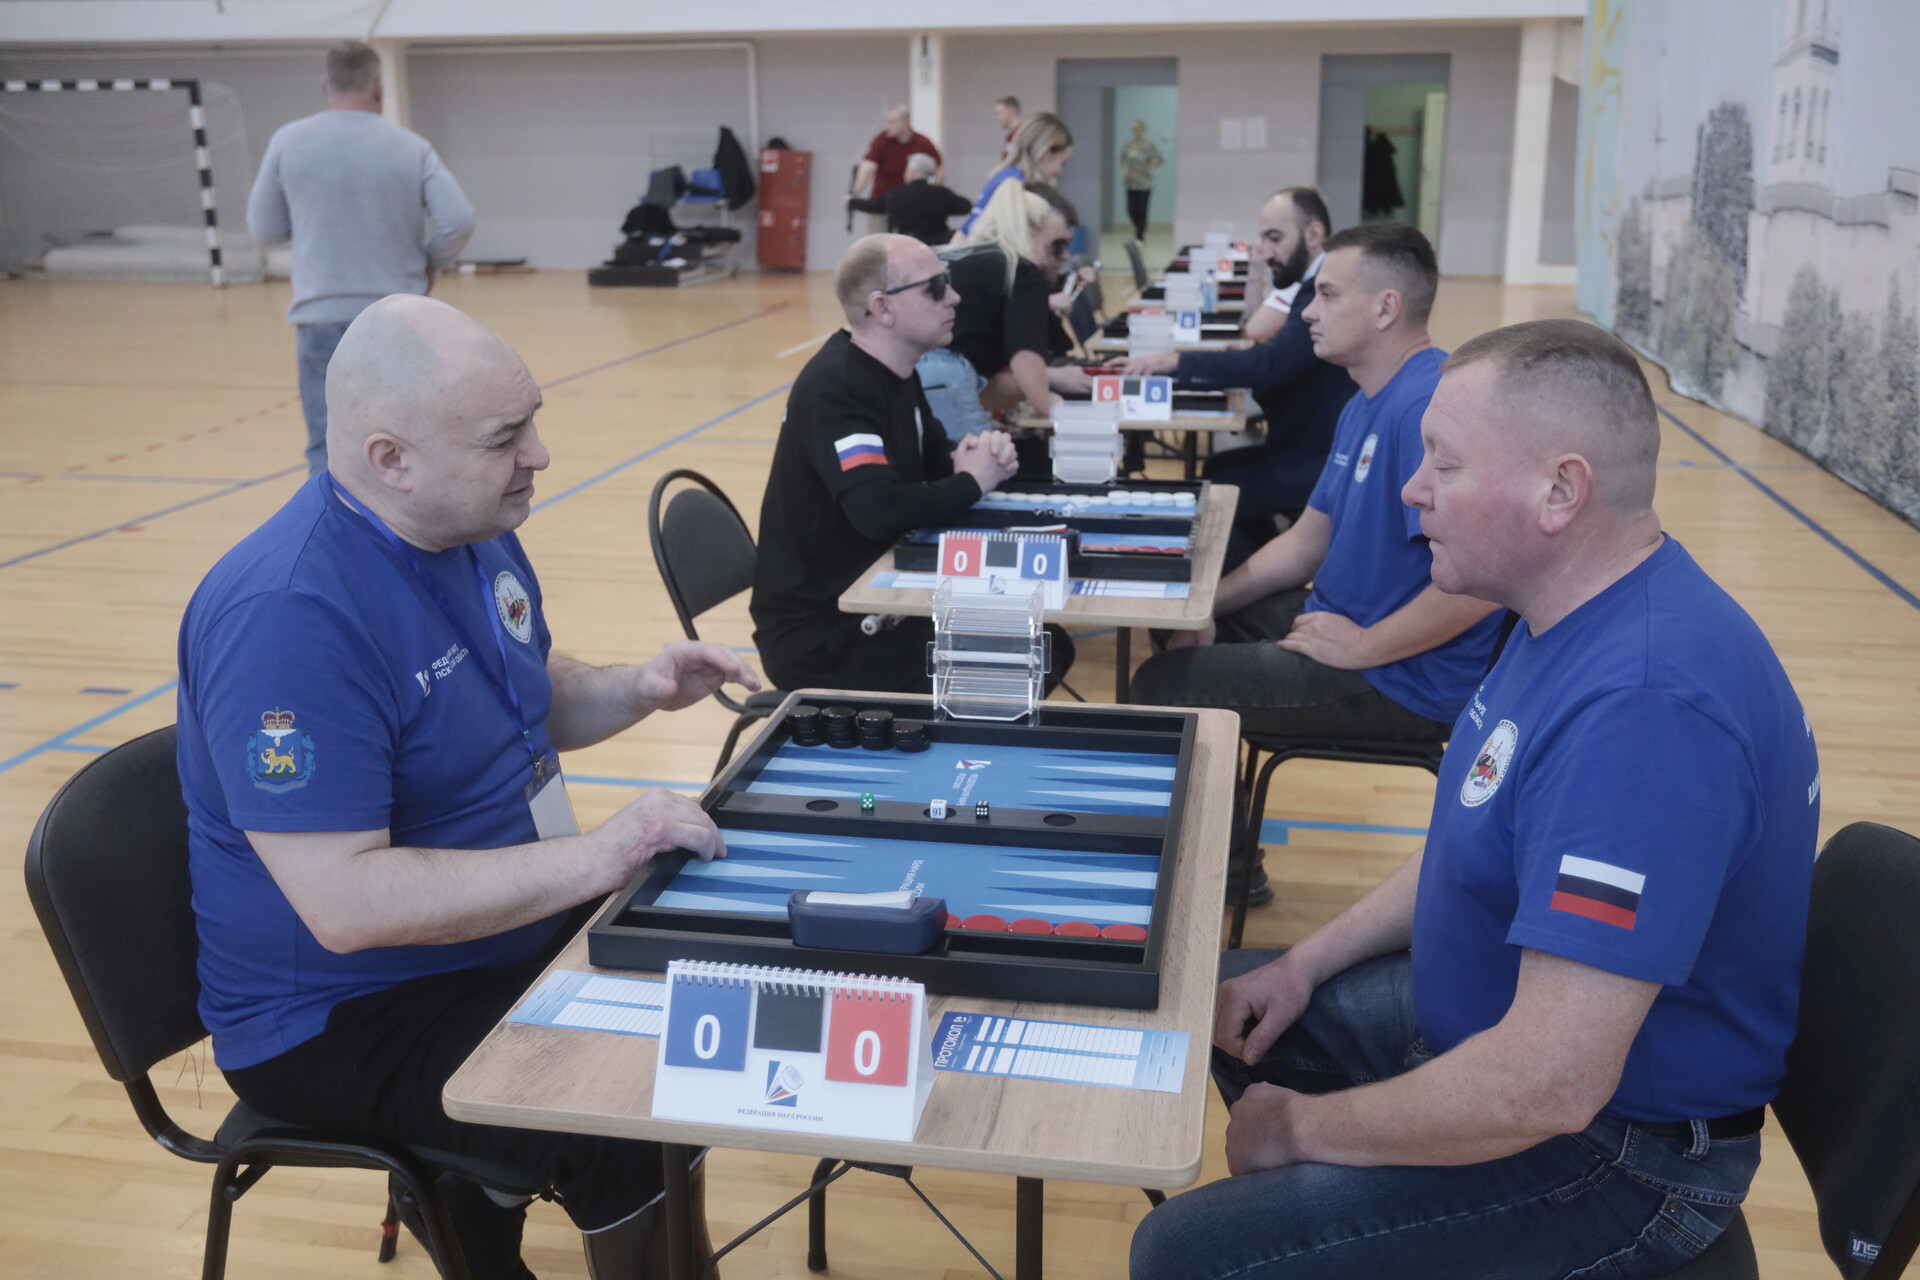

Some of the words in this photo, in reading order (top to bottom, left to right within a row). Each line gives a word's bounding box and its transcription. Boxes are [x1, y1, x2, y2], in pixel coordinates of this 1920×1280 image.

[1102, 385, 1113, 400] 0
[1151, 386, 1162, 401] 0
[953, 550, 968, 573] 0
[1032, 553, 1047, 575] 0
[694, 1014, 721, 1059] 0
[853, 1030, 881, 1076] 0
[934, 1024, 963, 1067] ПРОТОКОЛ
[737, 1108, 776, 1117] ФЕДЕРАЦИЯ
[777, 1111, 795, 1119] НАРД
[796, 1114, 823, 1122] РОССИИ
